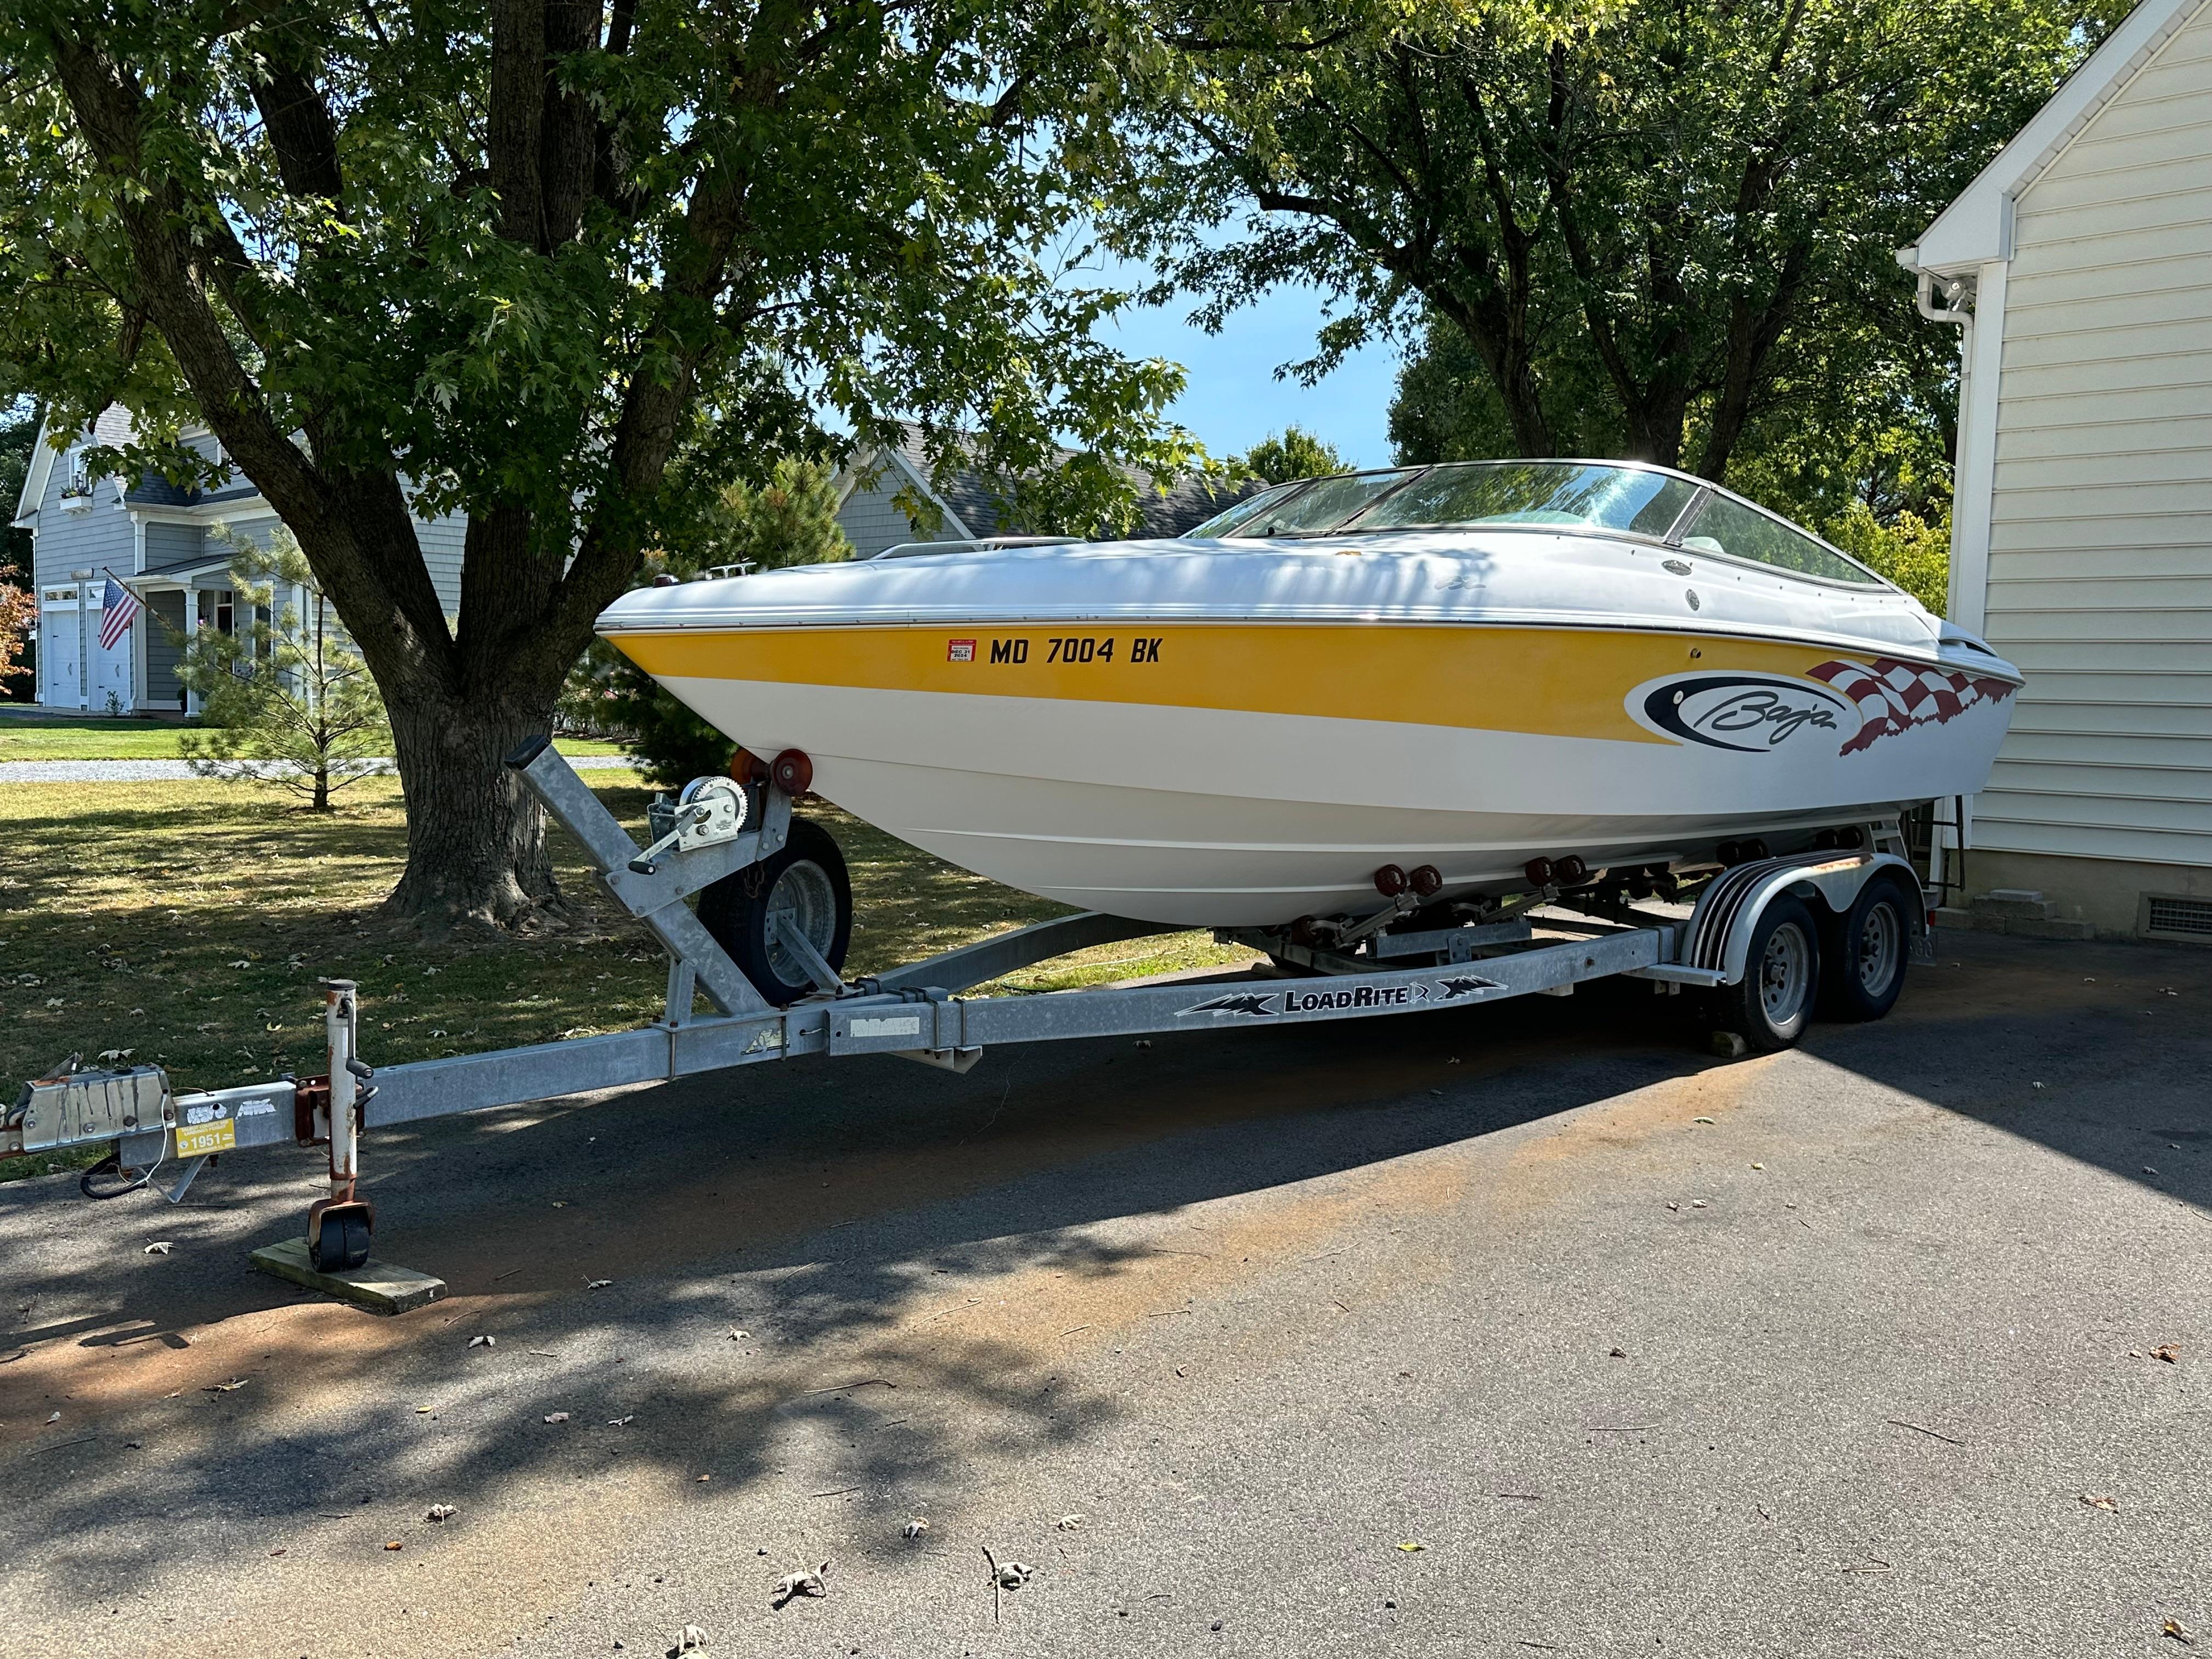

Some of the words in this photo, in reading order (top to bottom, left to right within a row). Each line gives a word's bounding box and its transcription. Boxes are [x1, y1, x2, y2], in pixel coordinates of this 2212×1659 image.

[989, 639, 1029, 664] MD
[1046, 637, 1114, 663] 7004
[1130, 637, 1163, 663] BK
[1693, 691, 1837, 745] Baja
[191, 1132, 220, 1149] 1951
